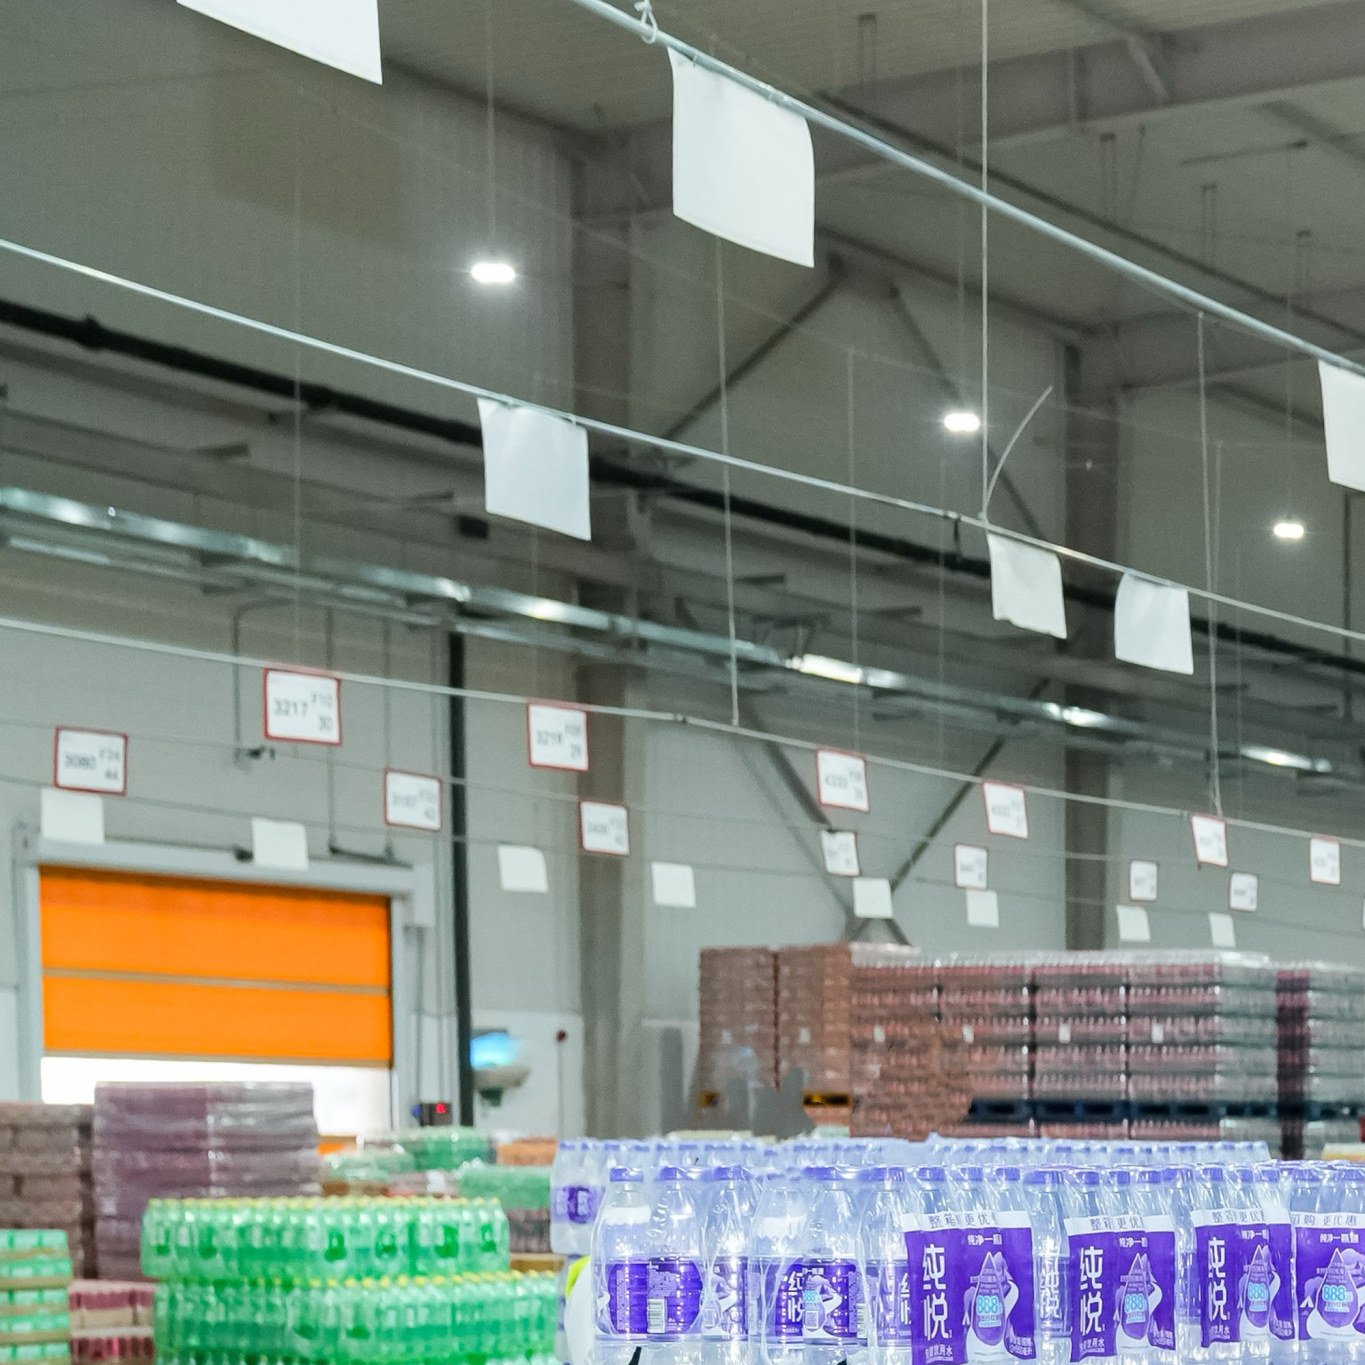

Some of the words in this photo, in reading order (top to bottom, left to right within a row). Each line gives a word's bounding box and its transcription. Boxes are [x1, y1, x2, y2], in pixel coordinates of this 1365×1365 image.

[274, 699, 308, 716] 3217
[1323, 1216, 1356, 1226] 更优惠
[923, 1243, 949, 1341] 纯悦
